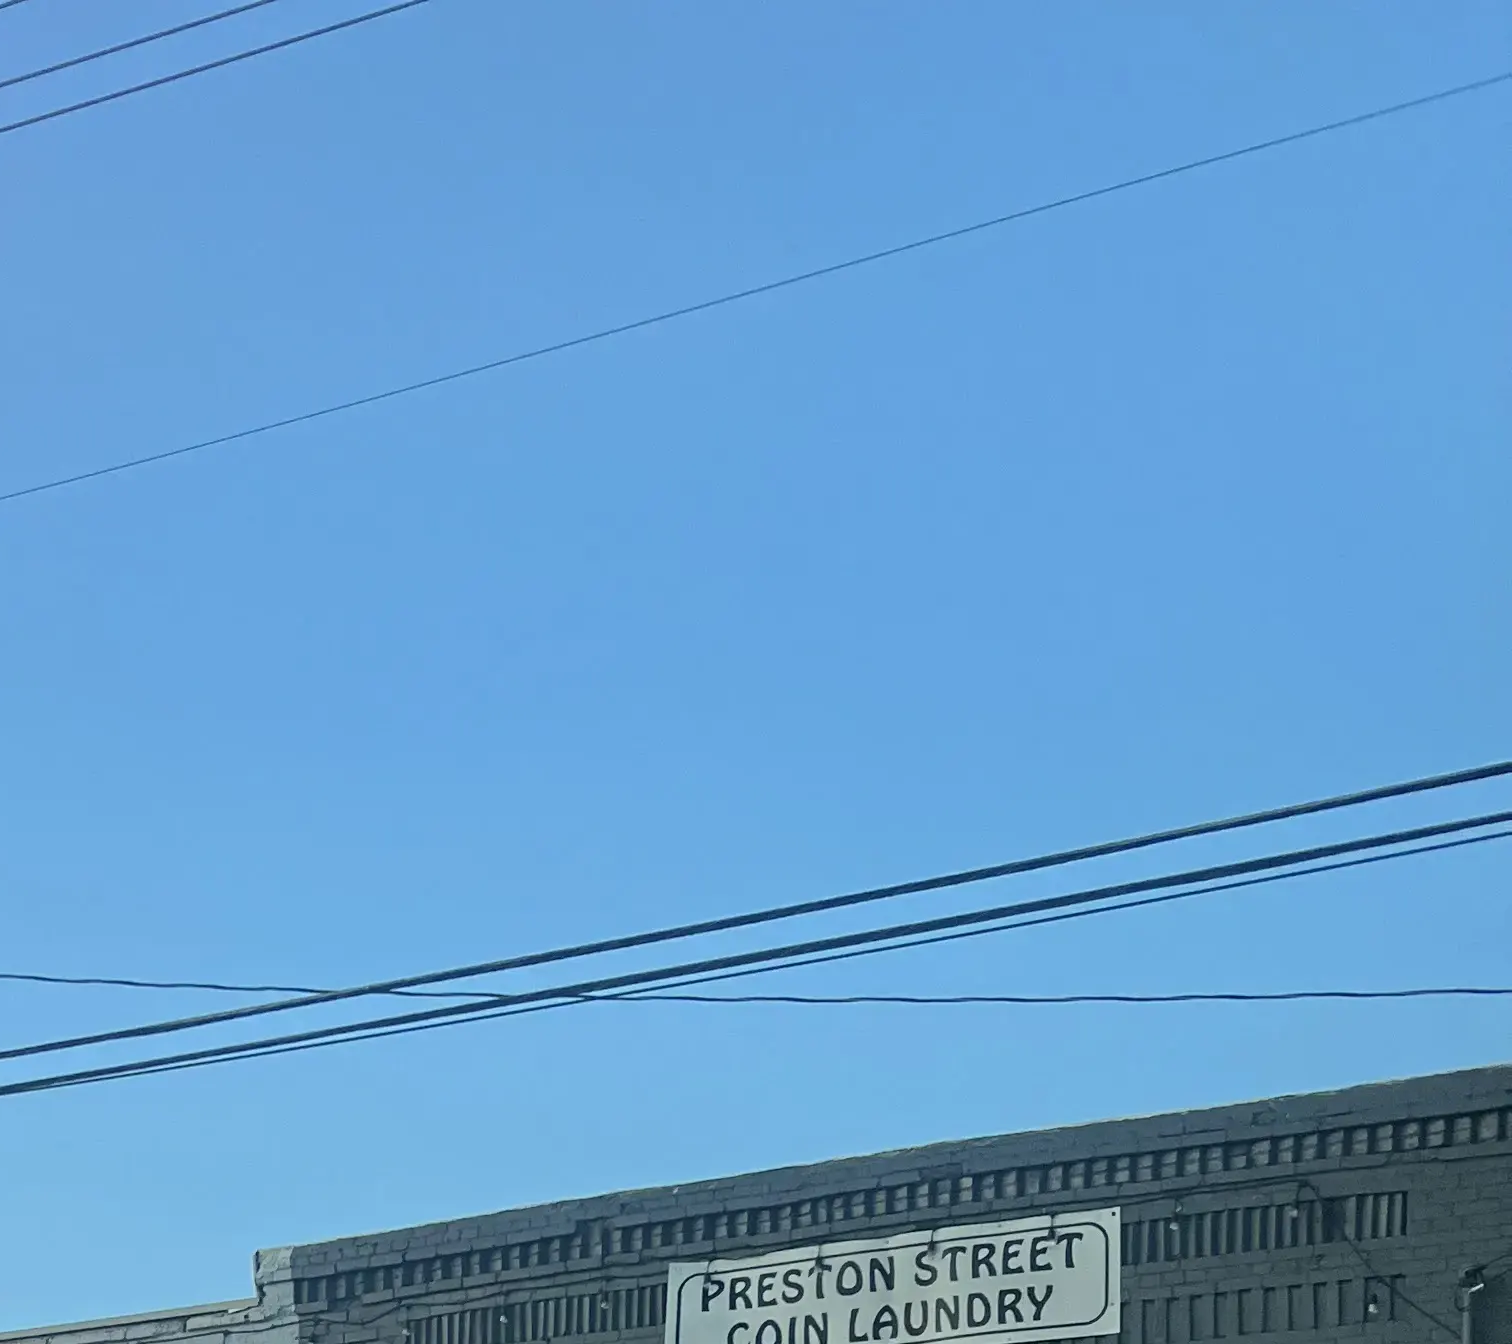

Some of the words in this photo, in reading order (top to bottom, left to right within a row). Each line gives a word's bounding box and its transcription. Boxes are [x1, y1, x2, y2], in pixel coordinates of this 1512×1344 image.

[700, 1255, 896, 1313] PRESTON
[914, 1231, 1084, 1287] STREET
[848, 1284, 1054, 1343] LAUNDRY
